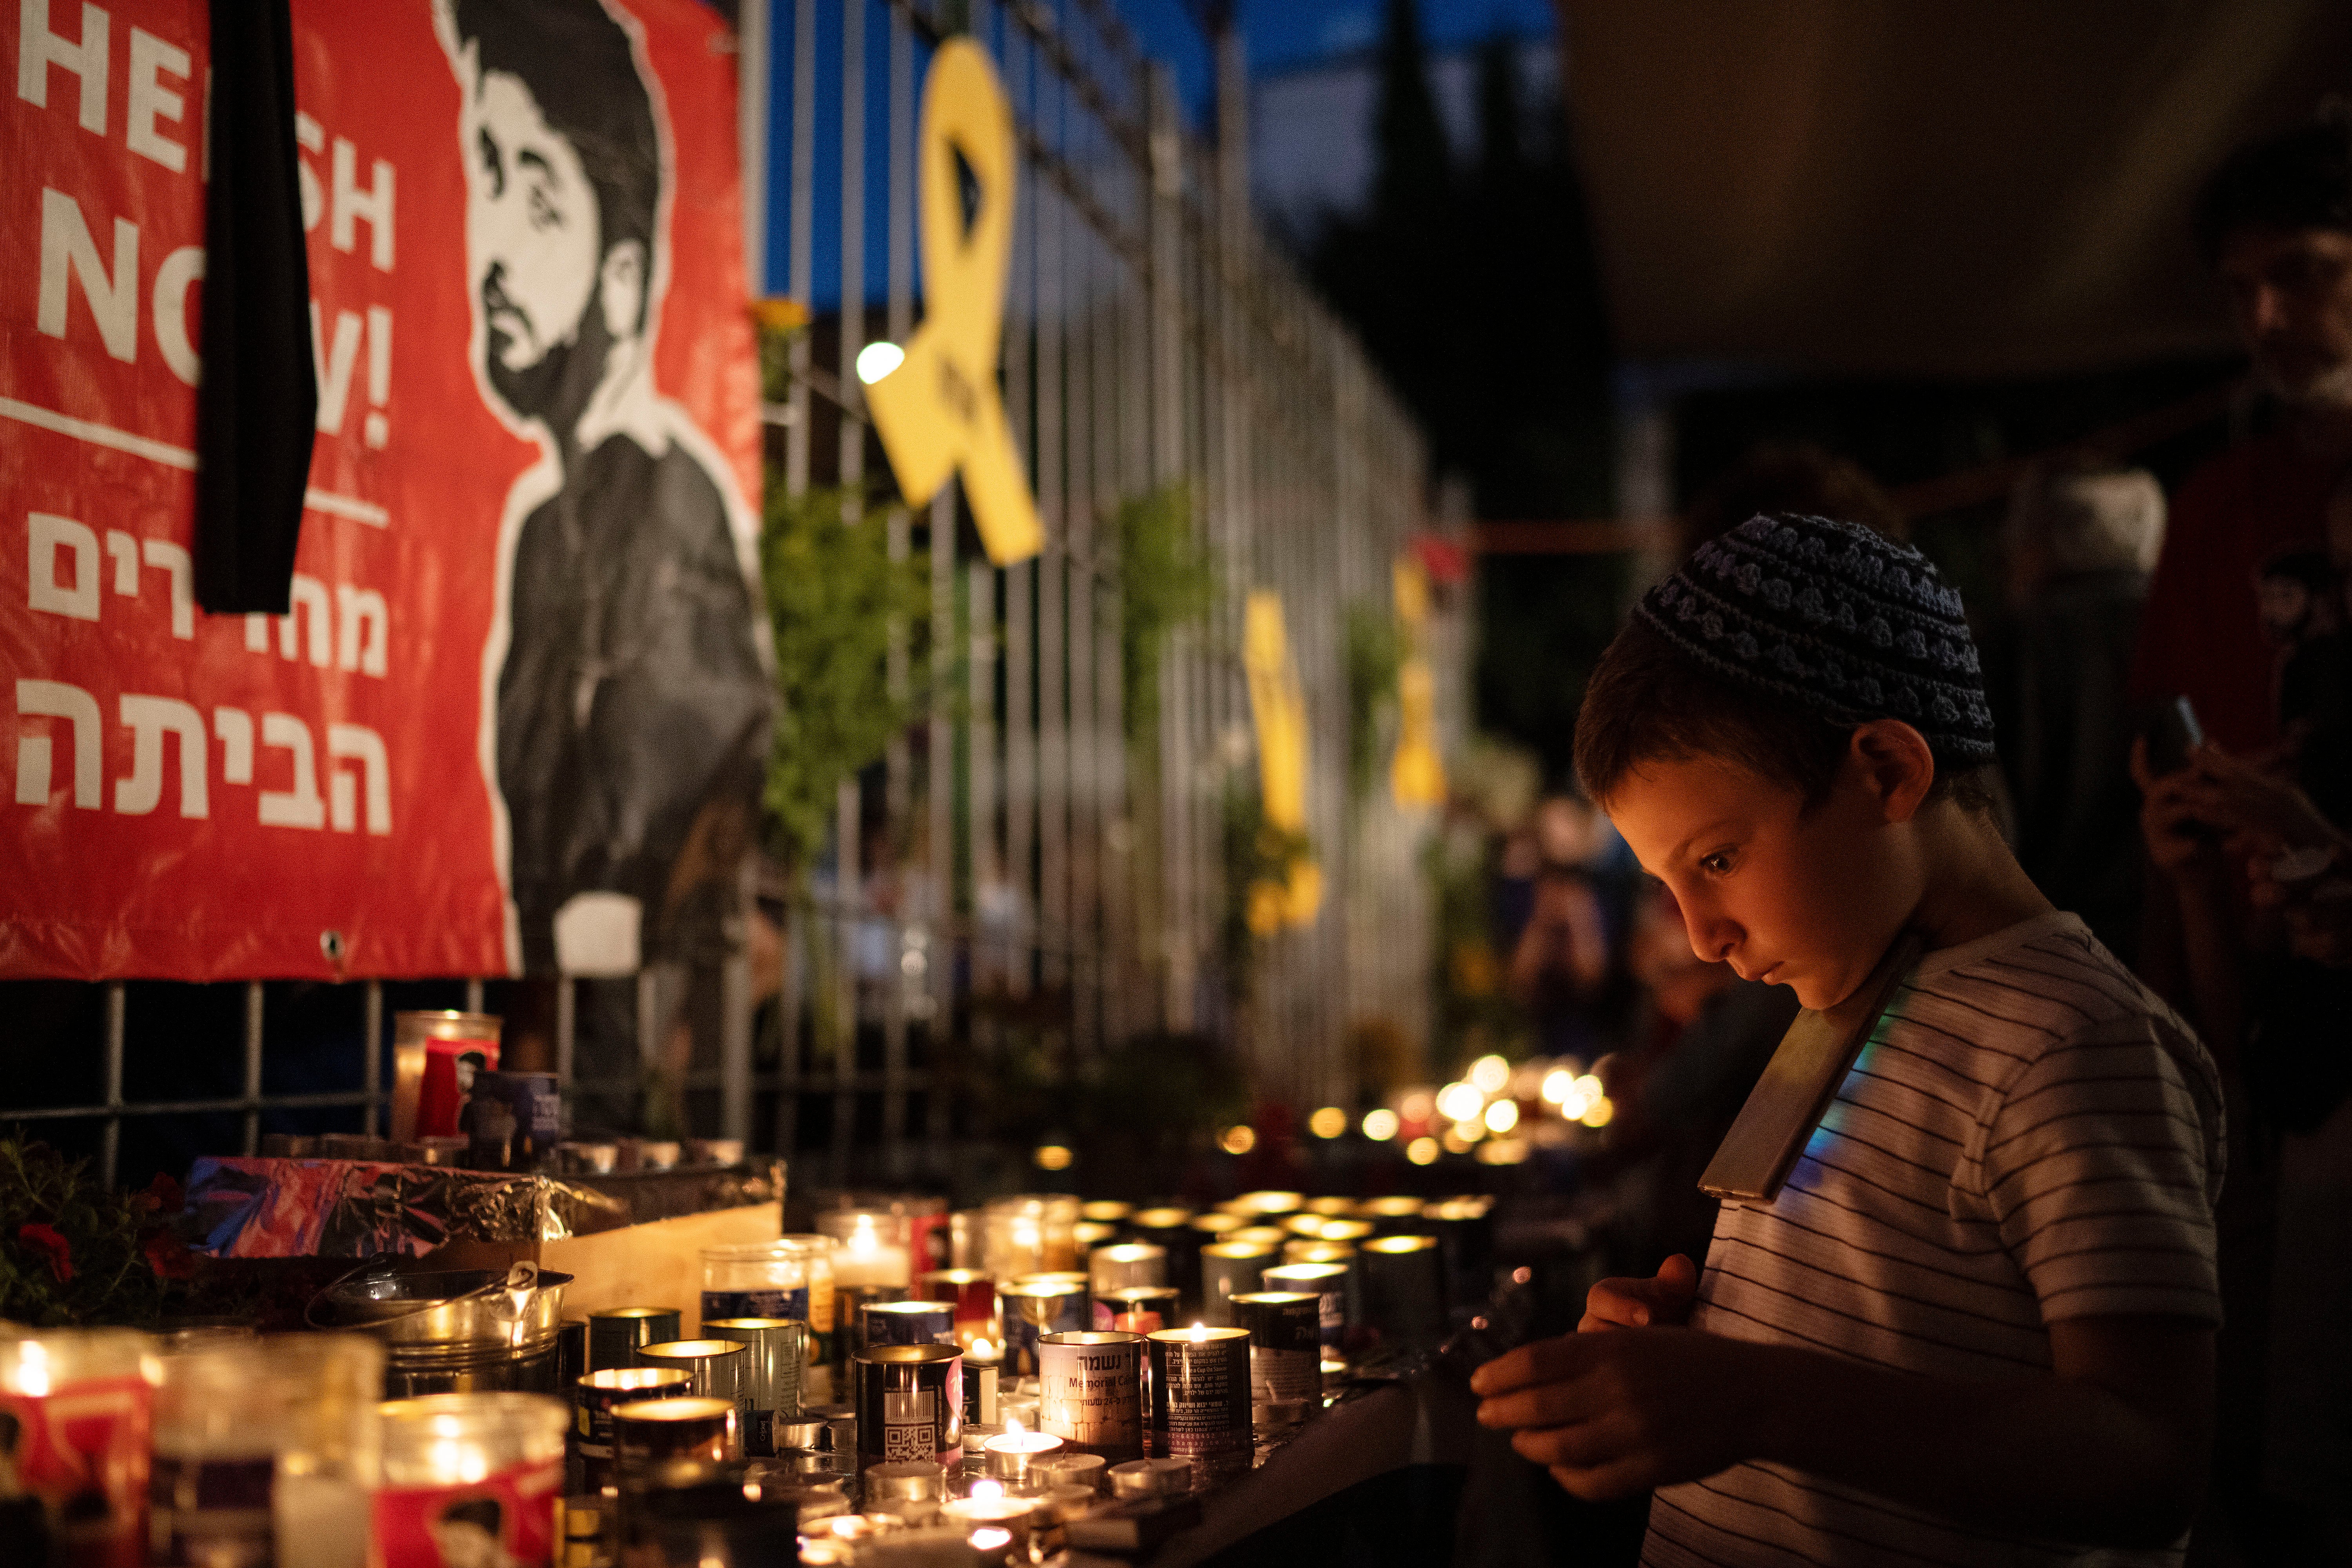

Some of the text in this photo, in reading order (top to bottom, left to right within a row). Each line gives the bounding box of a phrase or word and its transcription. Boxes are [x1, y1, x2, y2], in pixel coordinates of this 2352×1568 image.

[17, 0, 396, 274] HESH
[15, 678, 392, 835] הביתה
[1069, 1376, 1116, 1388] Memorial
[1077, 1355, 1121, 1370] נשמה
